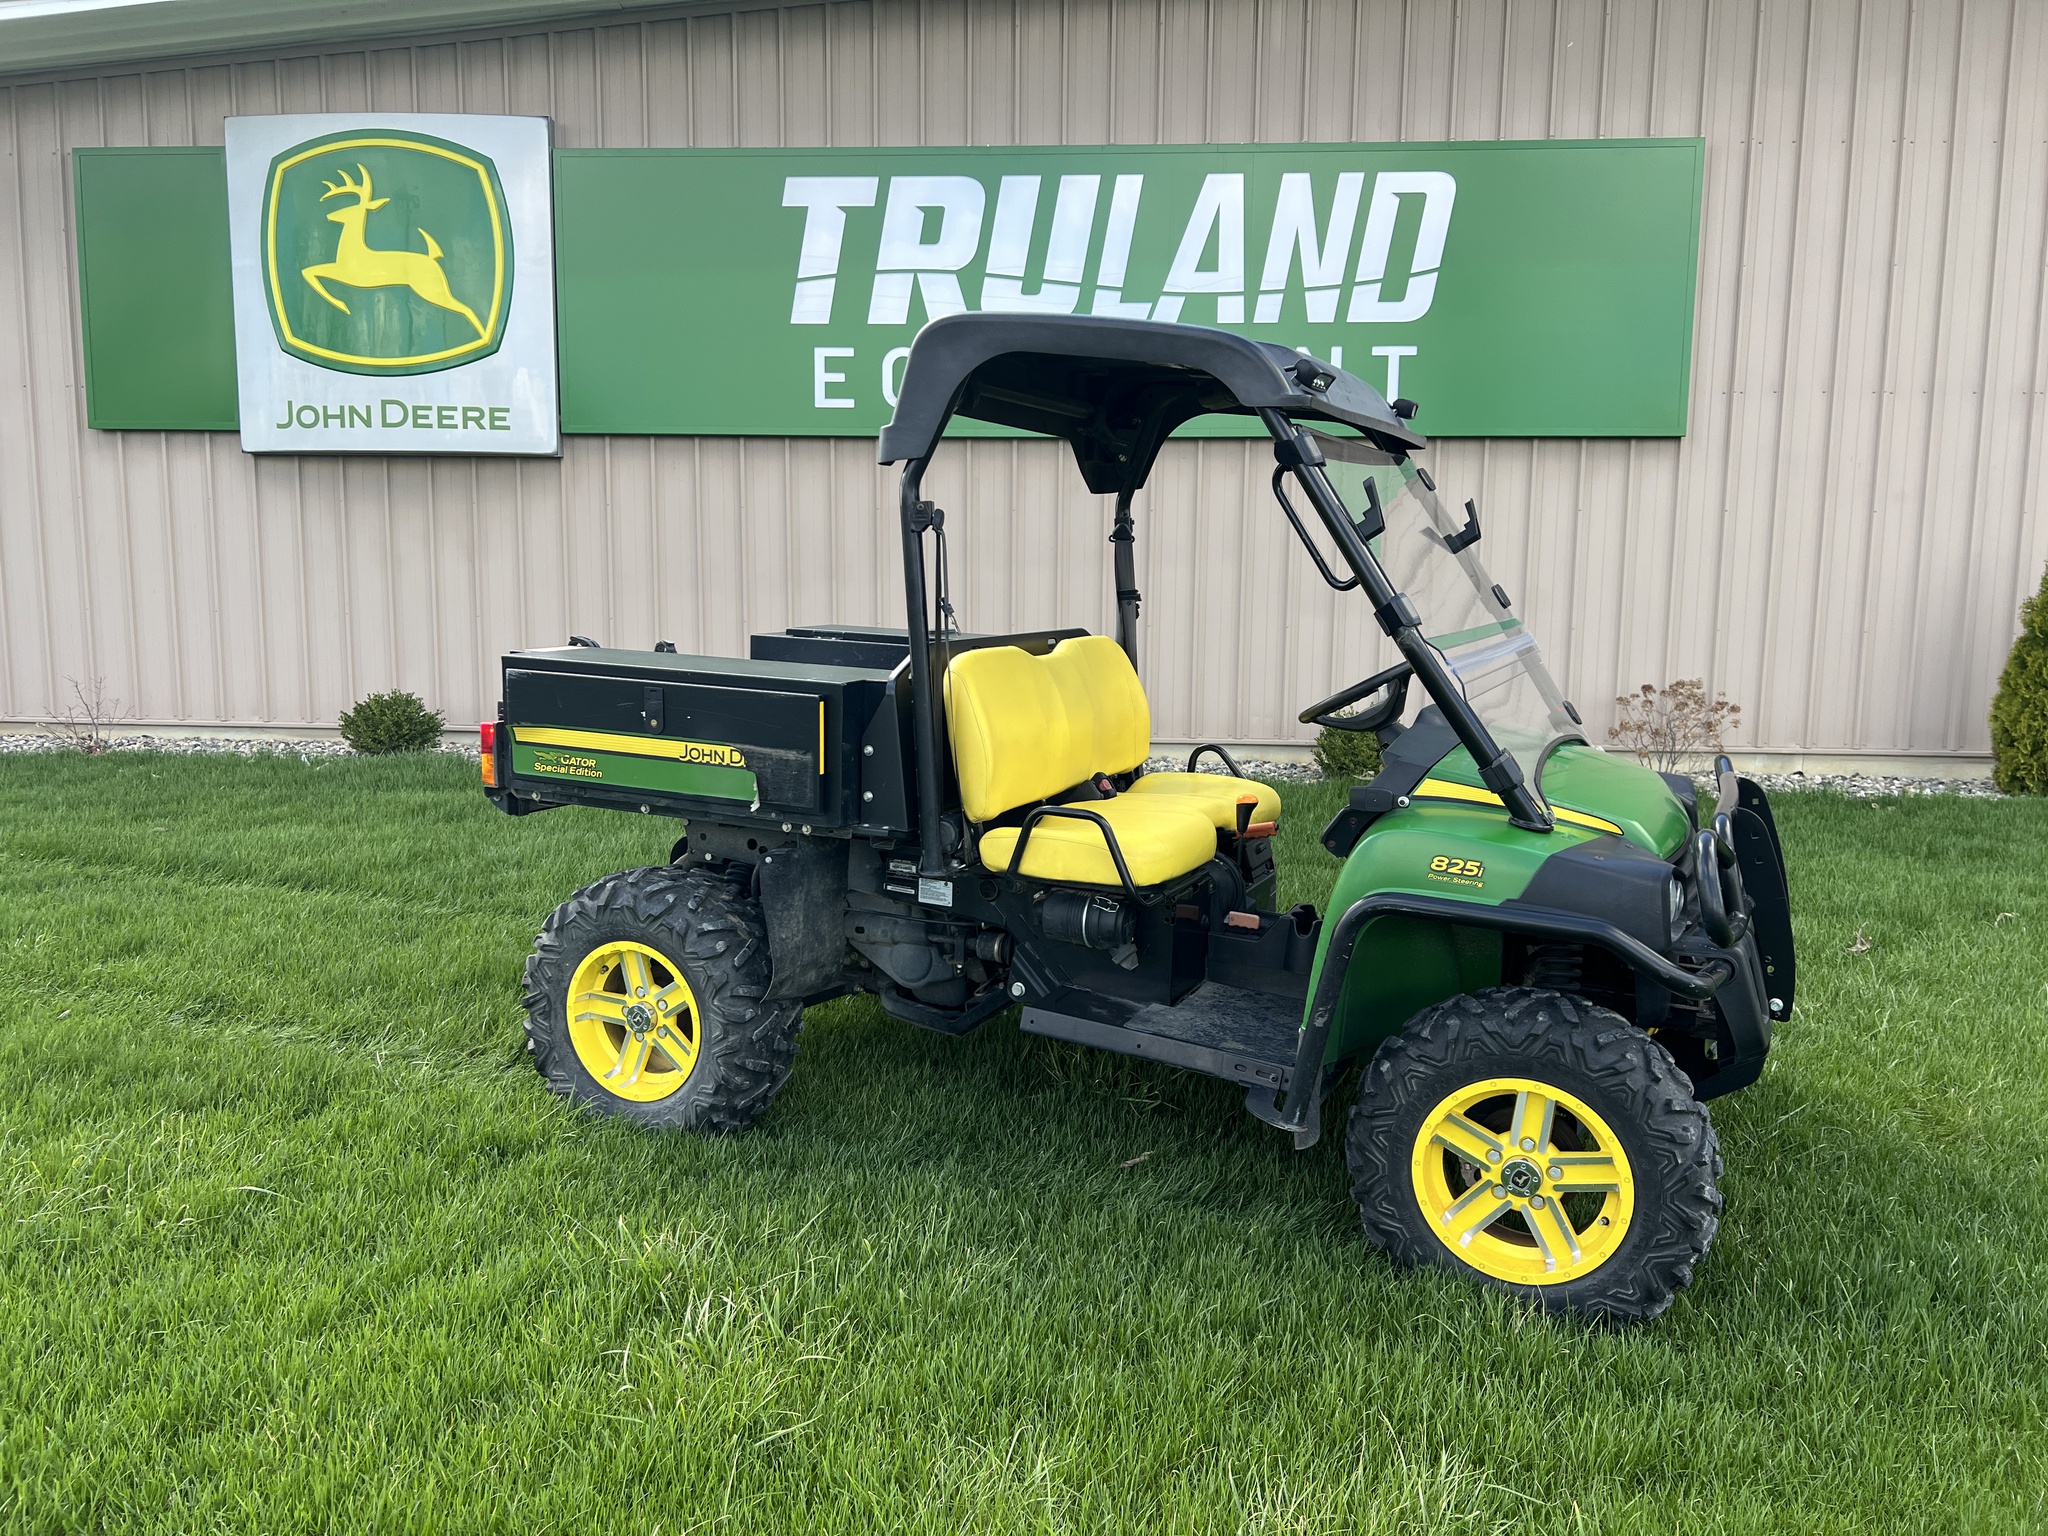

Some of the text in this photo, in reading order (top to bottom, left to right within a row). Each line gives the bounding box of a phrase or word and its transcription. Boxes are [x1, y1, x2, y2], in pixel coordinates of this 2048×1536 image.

[781, 171, 1457, 325] TRULAND
[276, 398, 511, 431] JOHN DEERE
[560, 754, 597, 768] GATOR
[679, 744, 725, 764] JOHN
[534, 762, 603, 778] Special Edition
[1430, 855, 1485, 878] 825i
[1427, 873, 1484, 888] Power Steering
